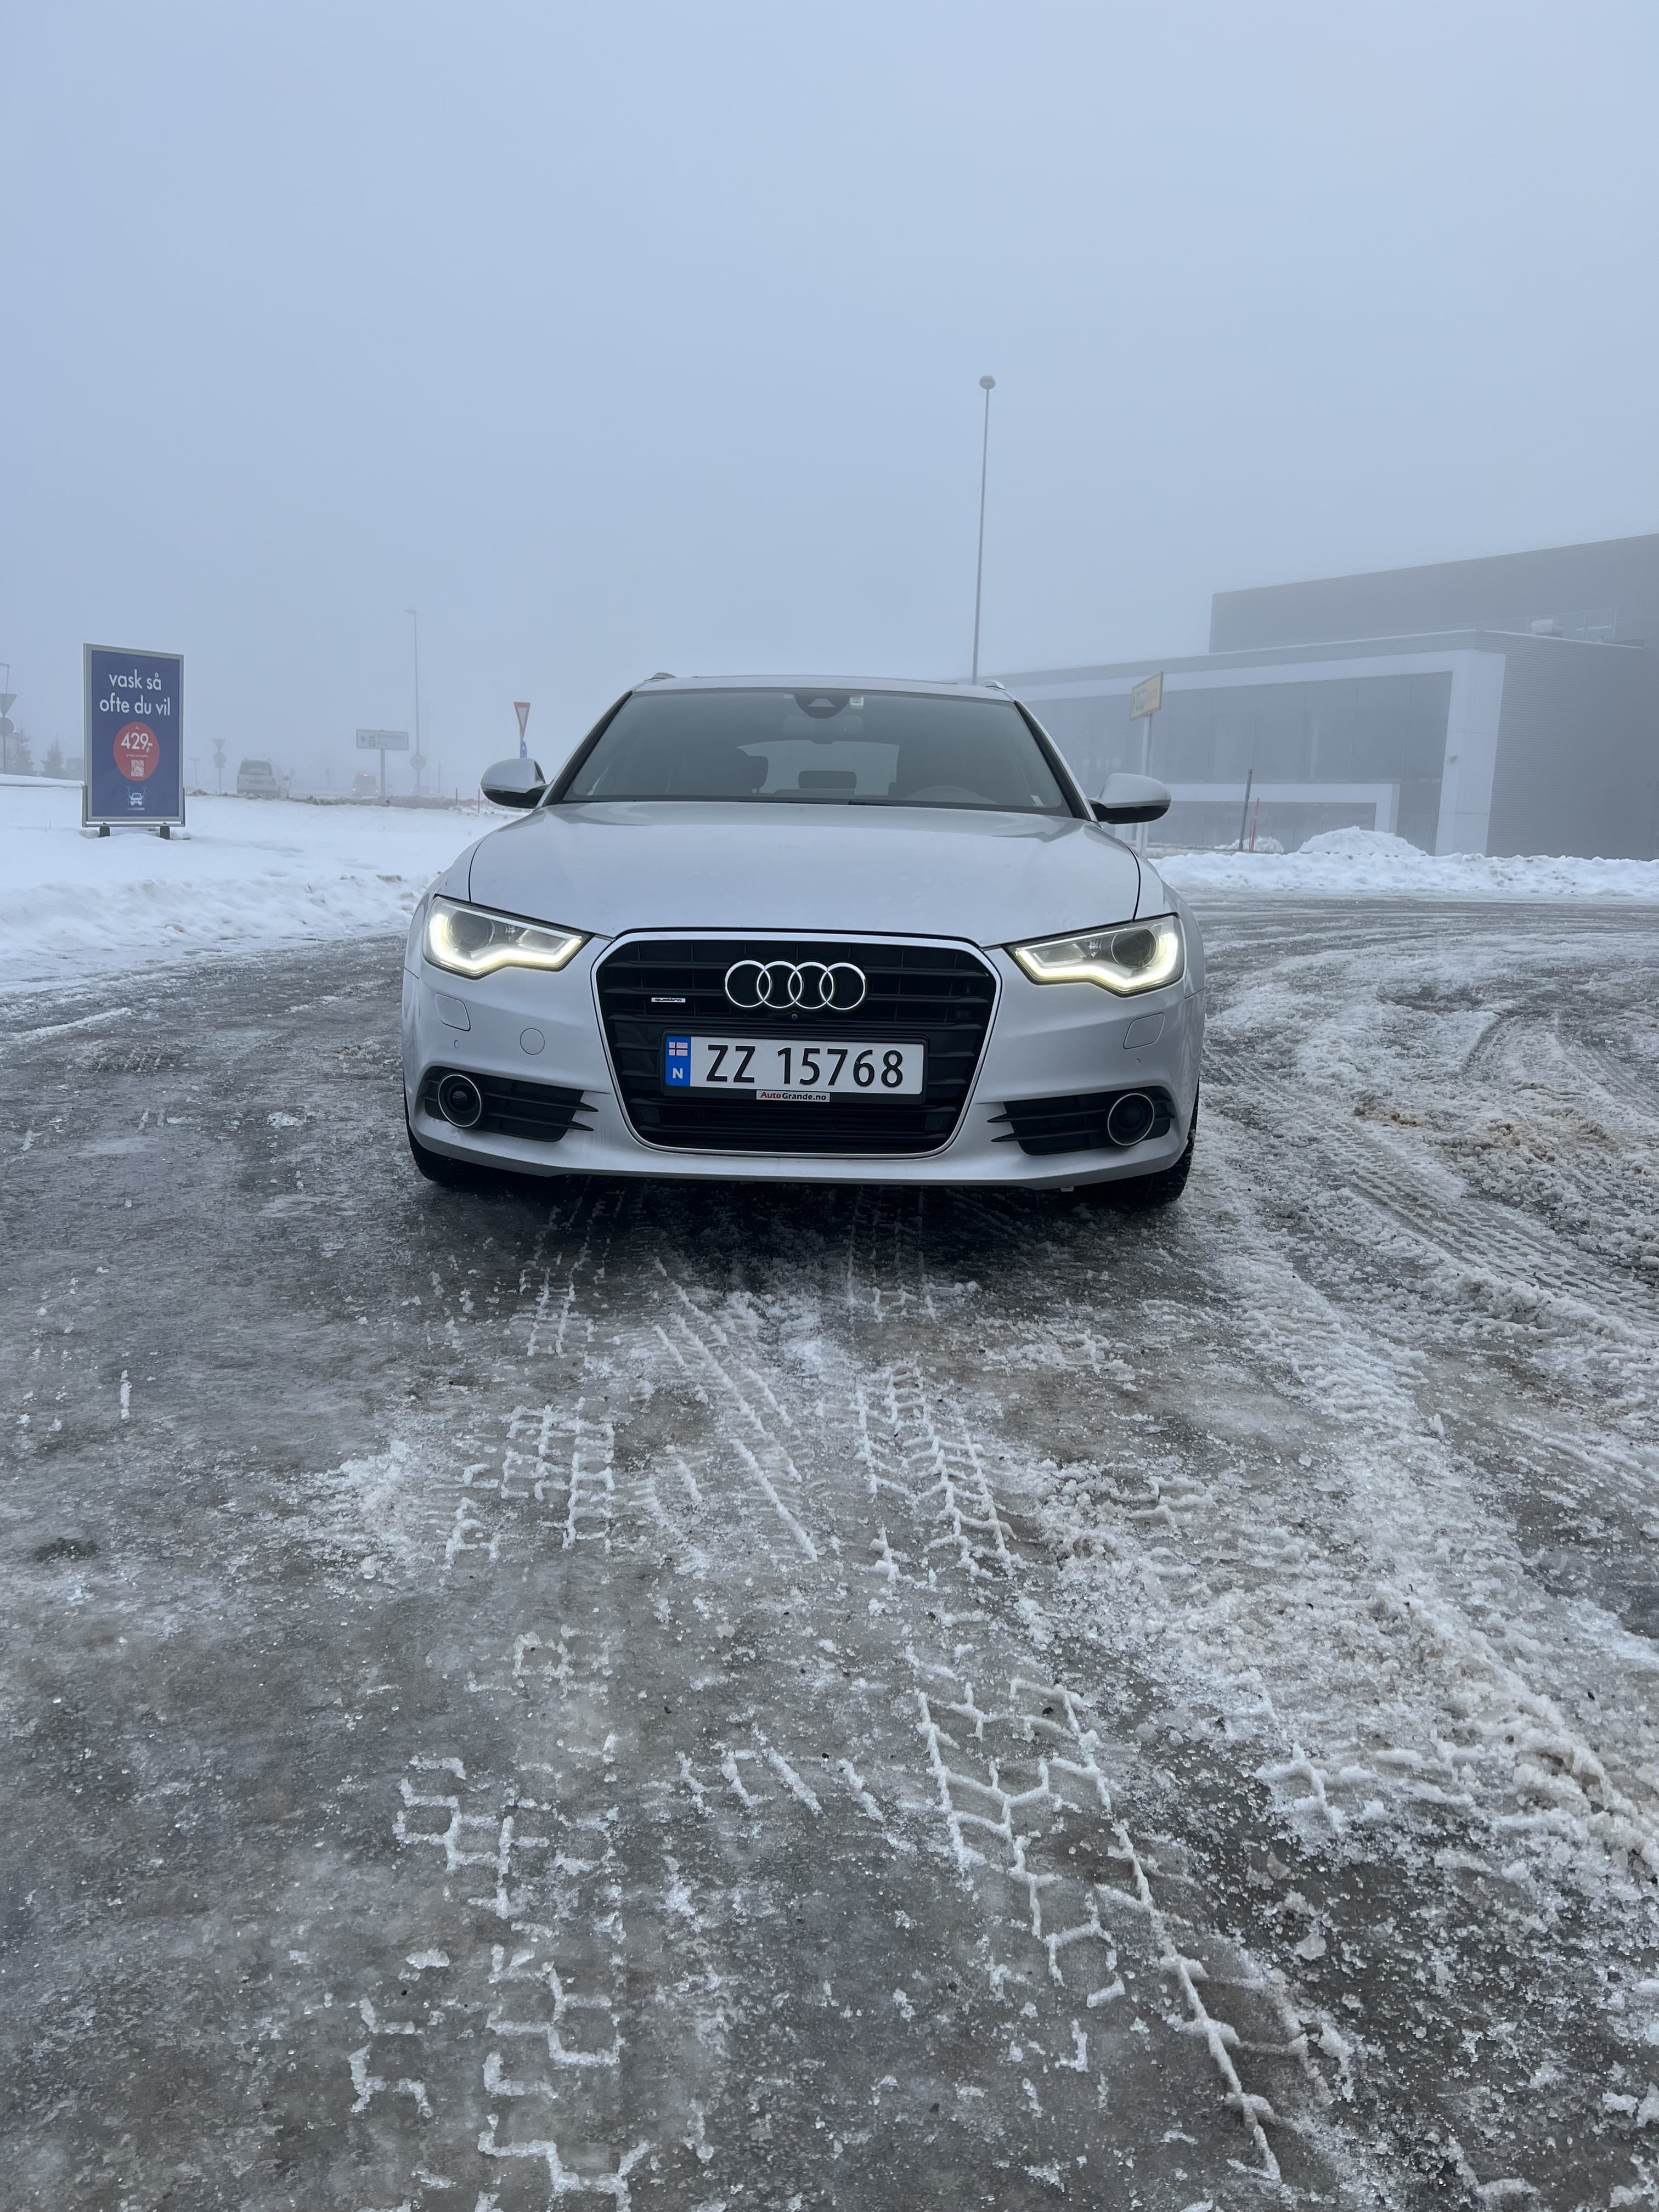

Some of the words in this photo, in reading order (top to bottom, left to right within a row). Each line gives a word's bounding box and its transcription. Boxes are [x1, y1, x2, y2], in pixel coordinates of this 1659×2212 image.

[109, 669, 143, 689] vask
[146, 673, 162, 691] så
[99, 692, 130, 713] ofte
[134, 695, 152, 715] du
[155, 697, 171, 716] vil
[672, 1068, 684, 1079] N
[706, 1044, 756, 1084] ZZ
[777, 1047, 904, 1088] 15768
[760, 1091, 827, 1101] AutoGrande.no
